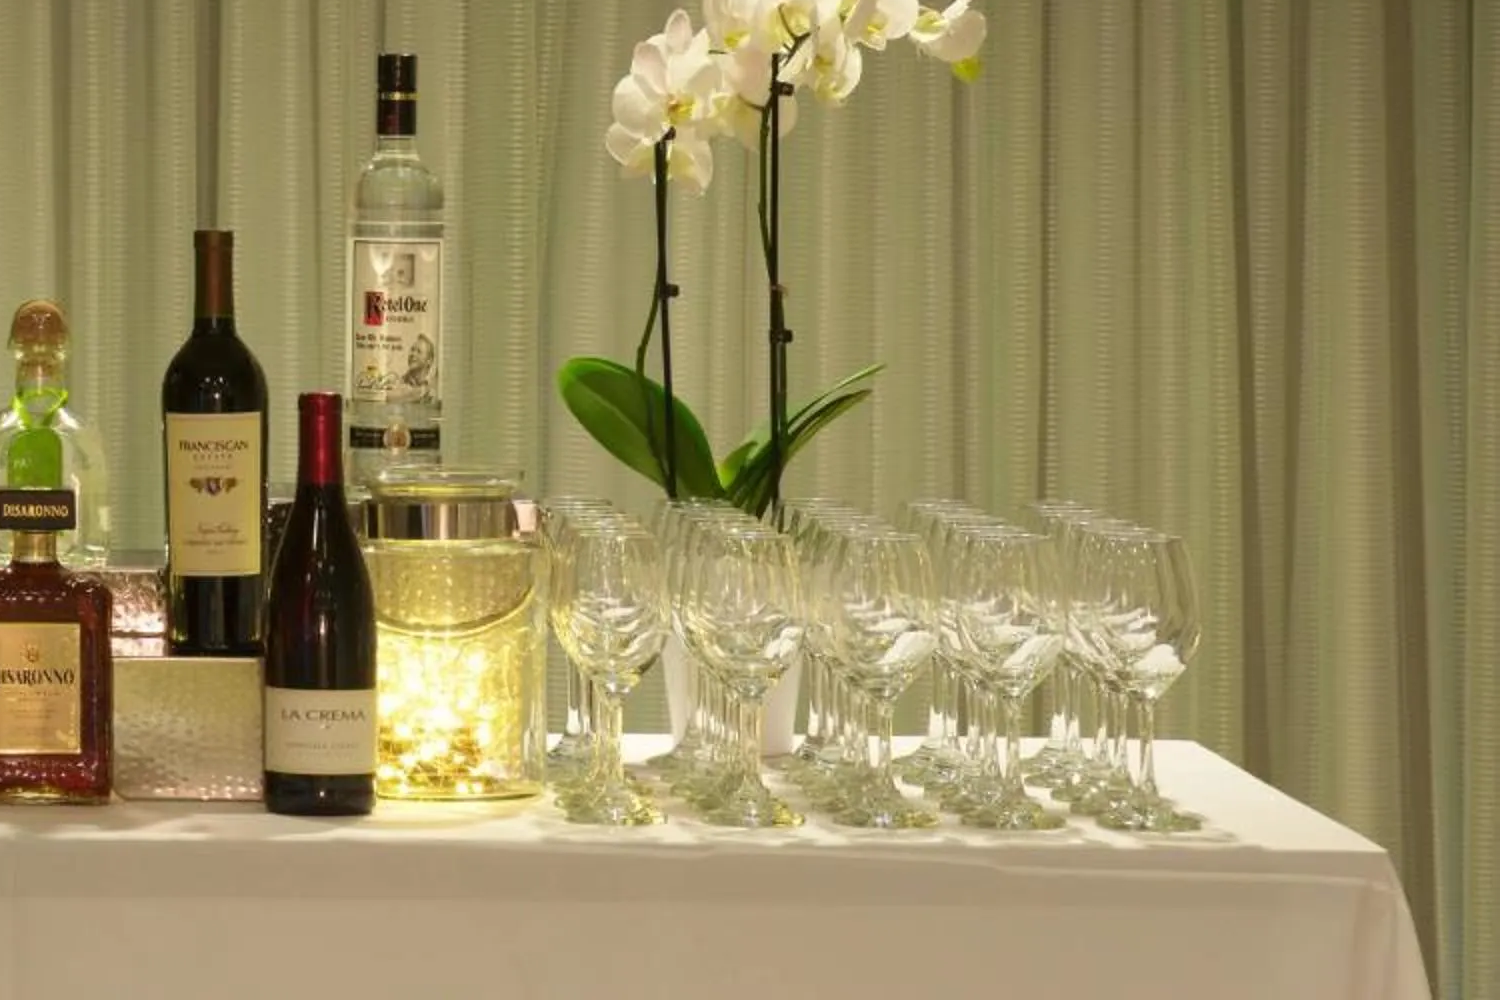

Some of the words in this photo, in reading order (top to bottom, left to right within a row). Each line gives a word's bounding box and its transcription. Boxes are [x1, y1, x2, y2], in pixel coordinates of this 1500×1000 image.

[179, 440, 249, 451] FRANCISCAN
[3, 503, 68, 517] DISARONNO
[281, 707, 301, 720] LA
[306, 708, 365, 720] CREMA
